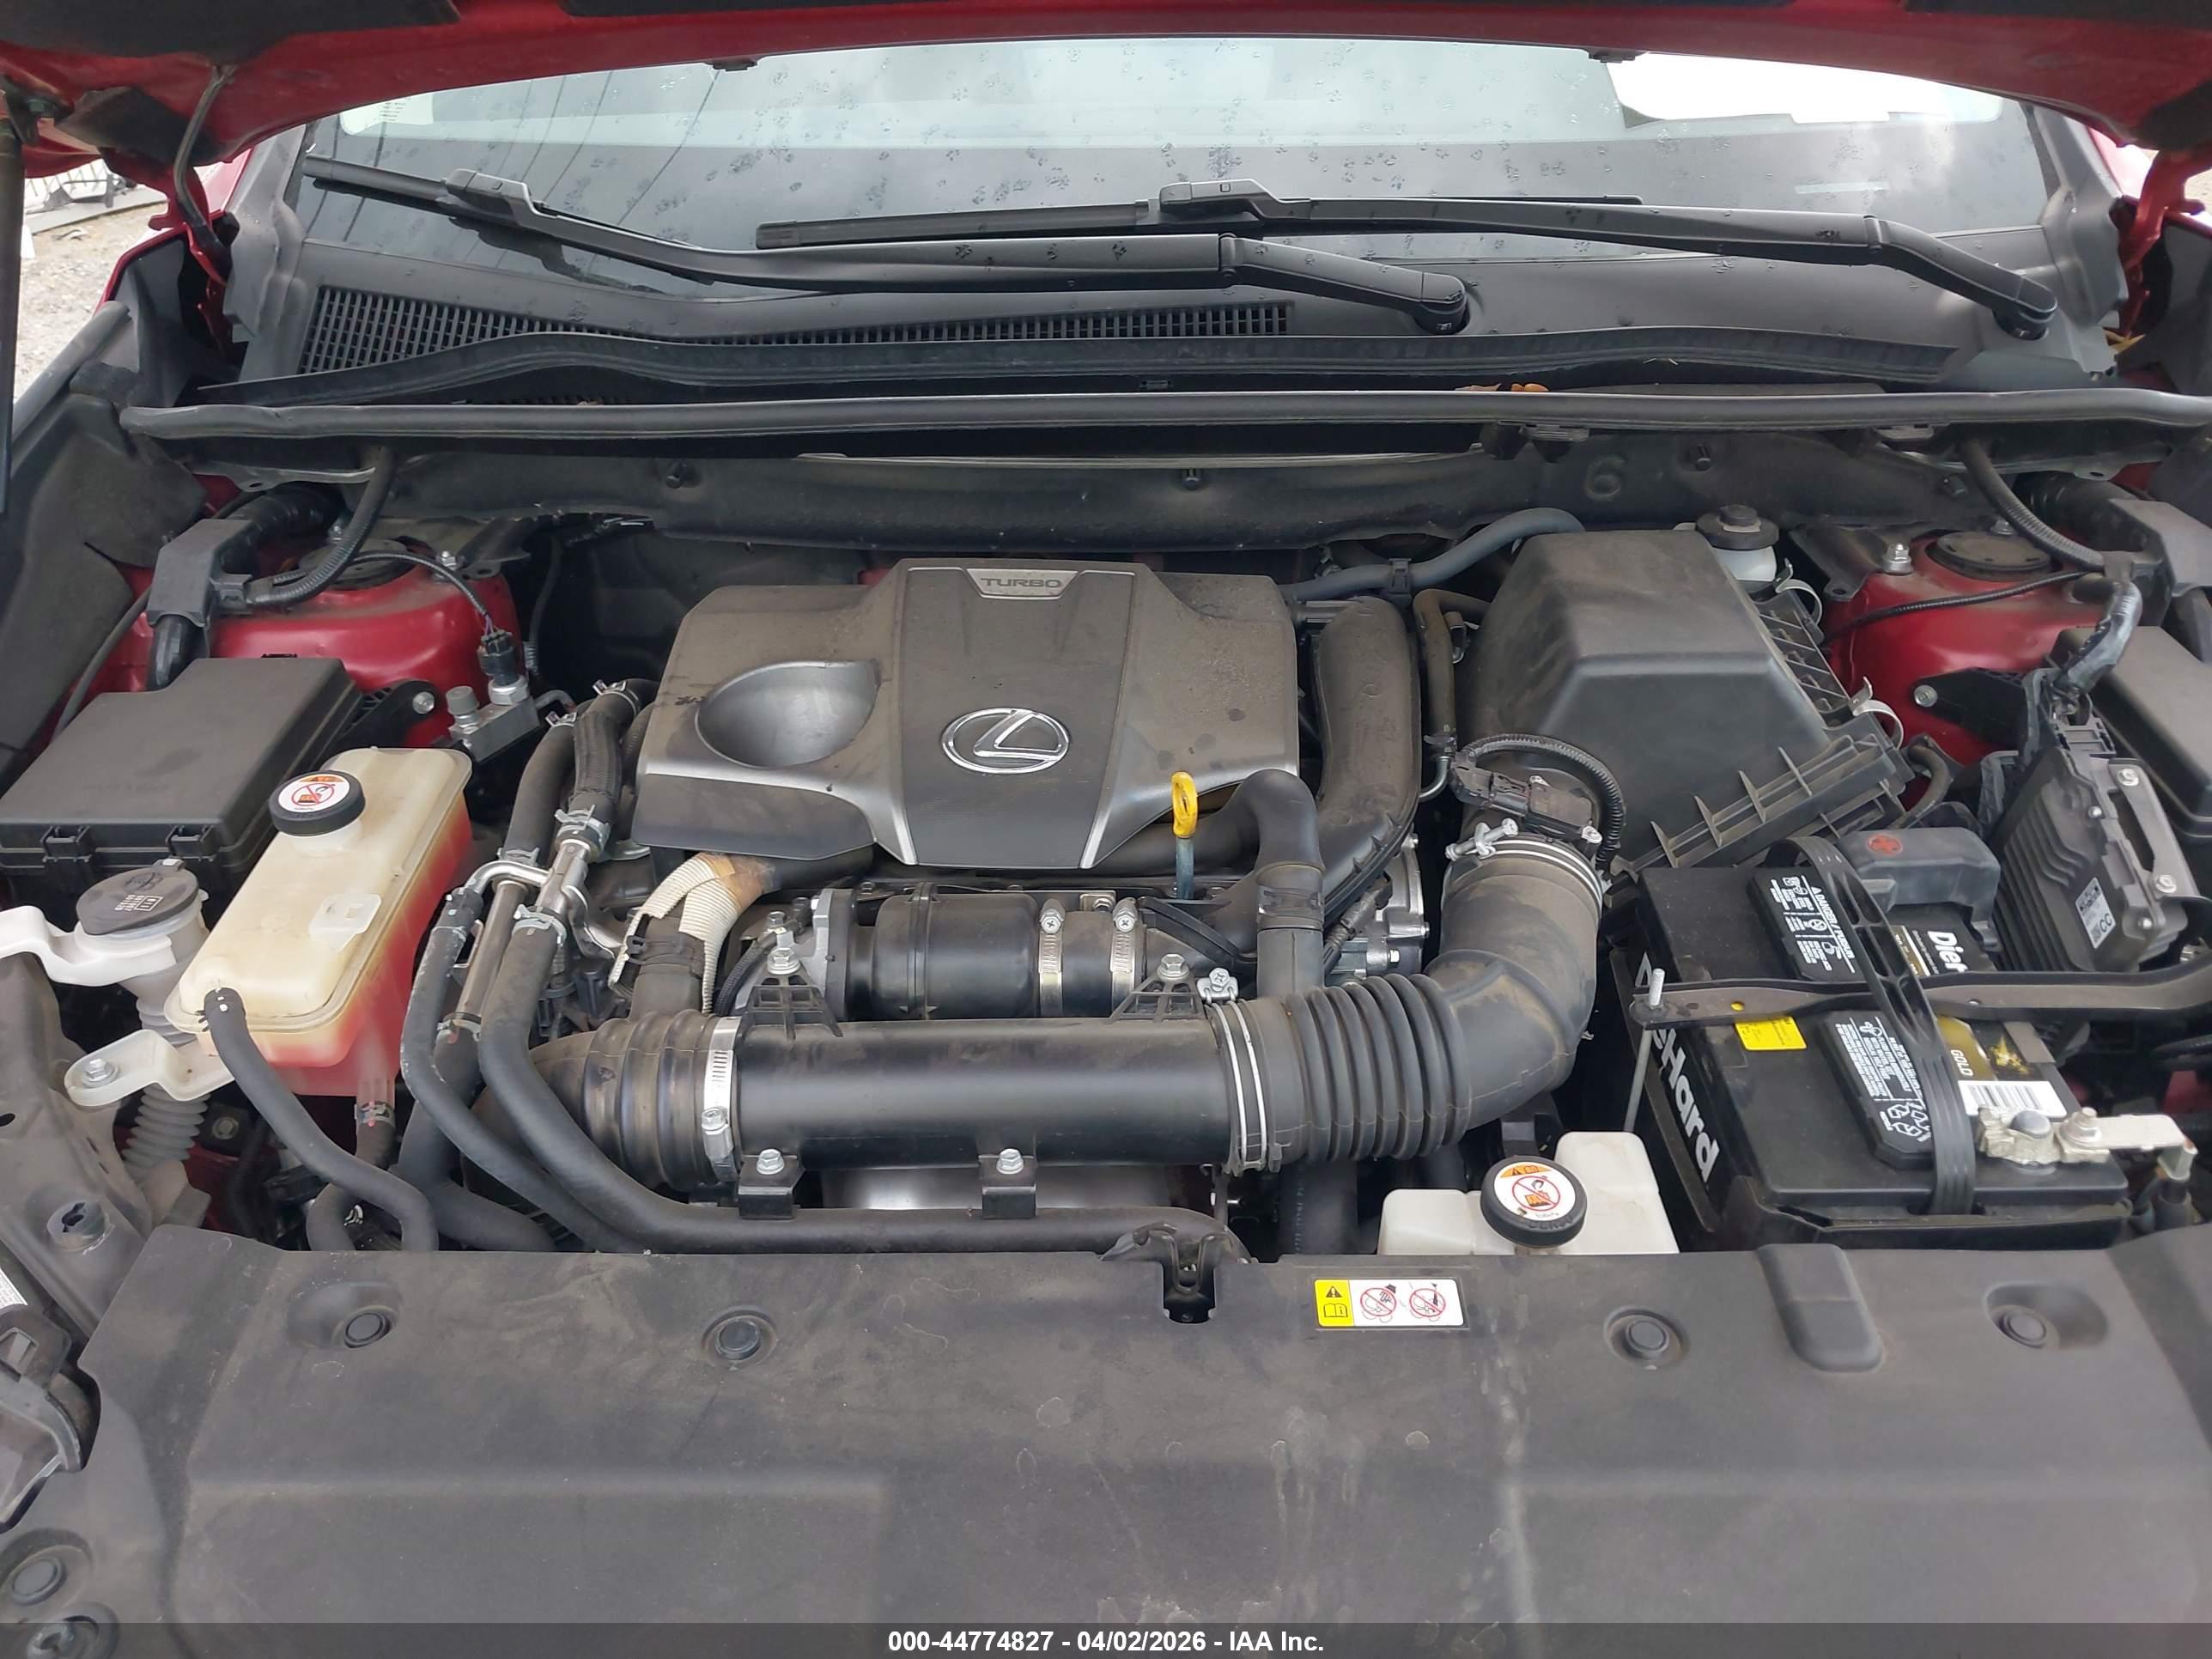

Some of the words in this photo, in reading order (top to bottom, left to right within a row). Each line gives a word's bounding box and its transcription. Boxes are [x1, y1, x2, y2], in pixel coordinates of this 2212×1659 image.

[980, 578, 1061, 588] TURBO
[1814, 895, 1838, 925] DANGER
[2100, 913, 2113, 933] CC
[1950, 1049, 1974, 1077] GOLD
